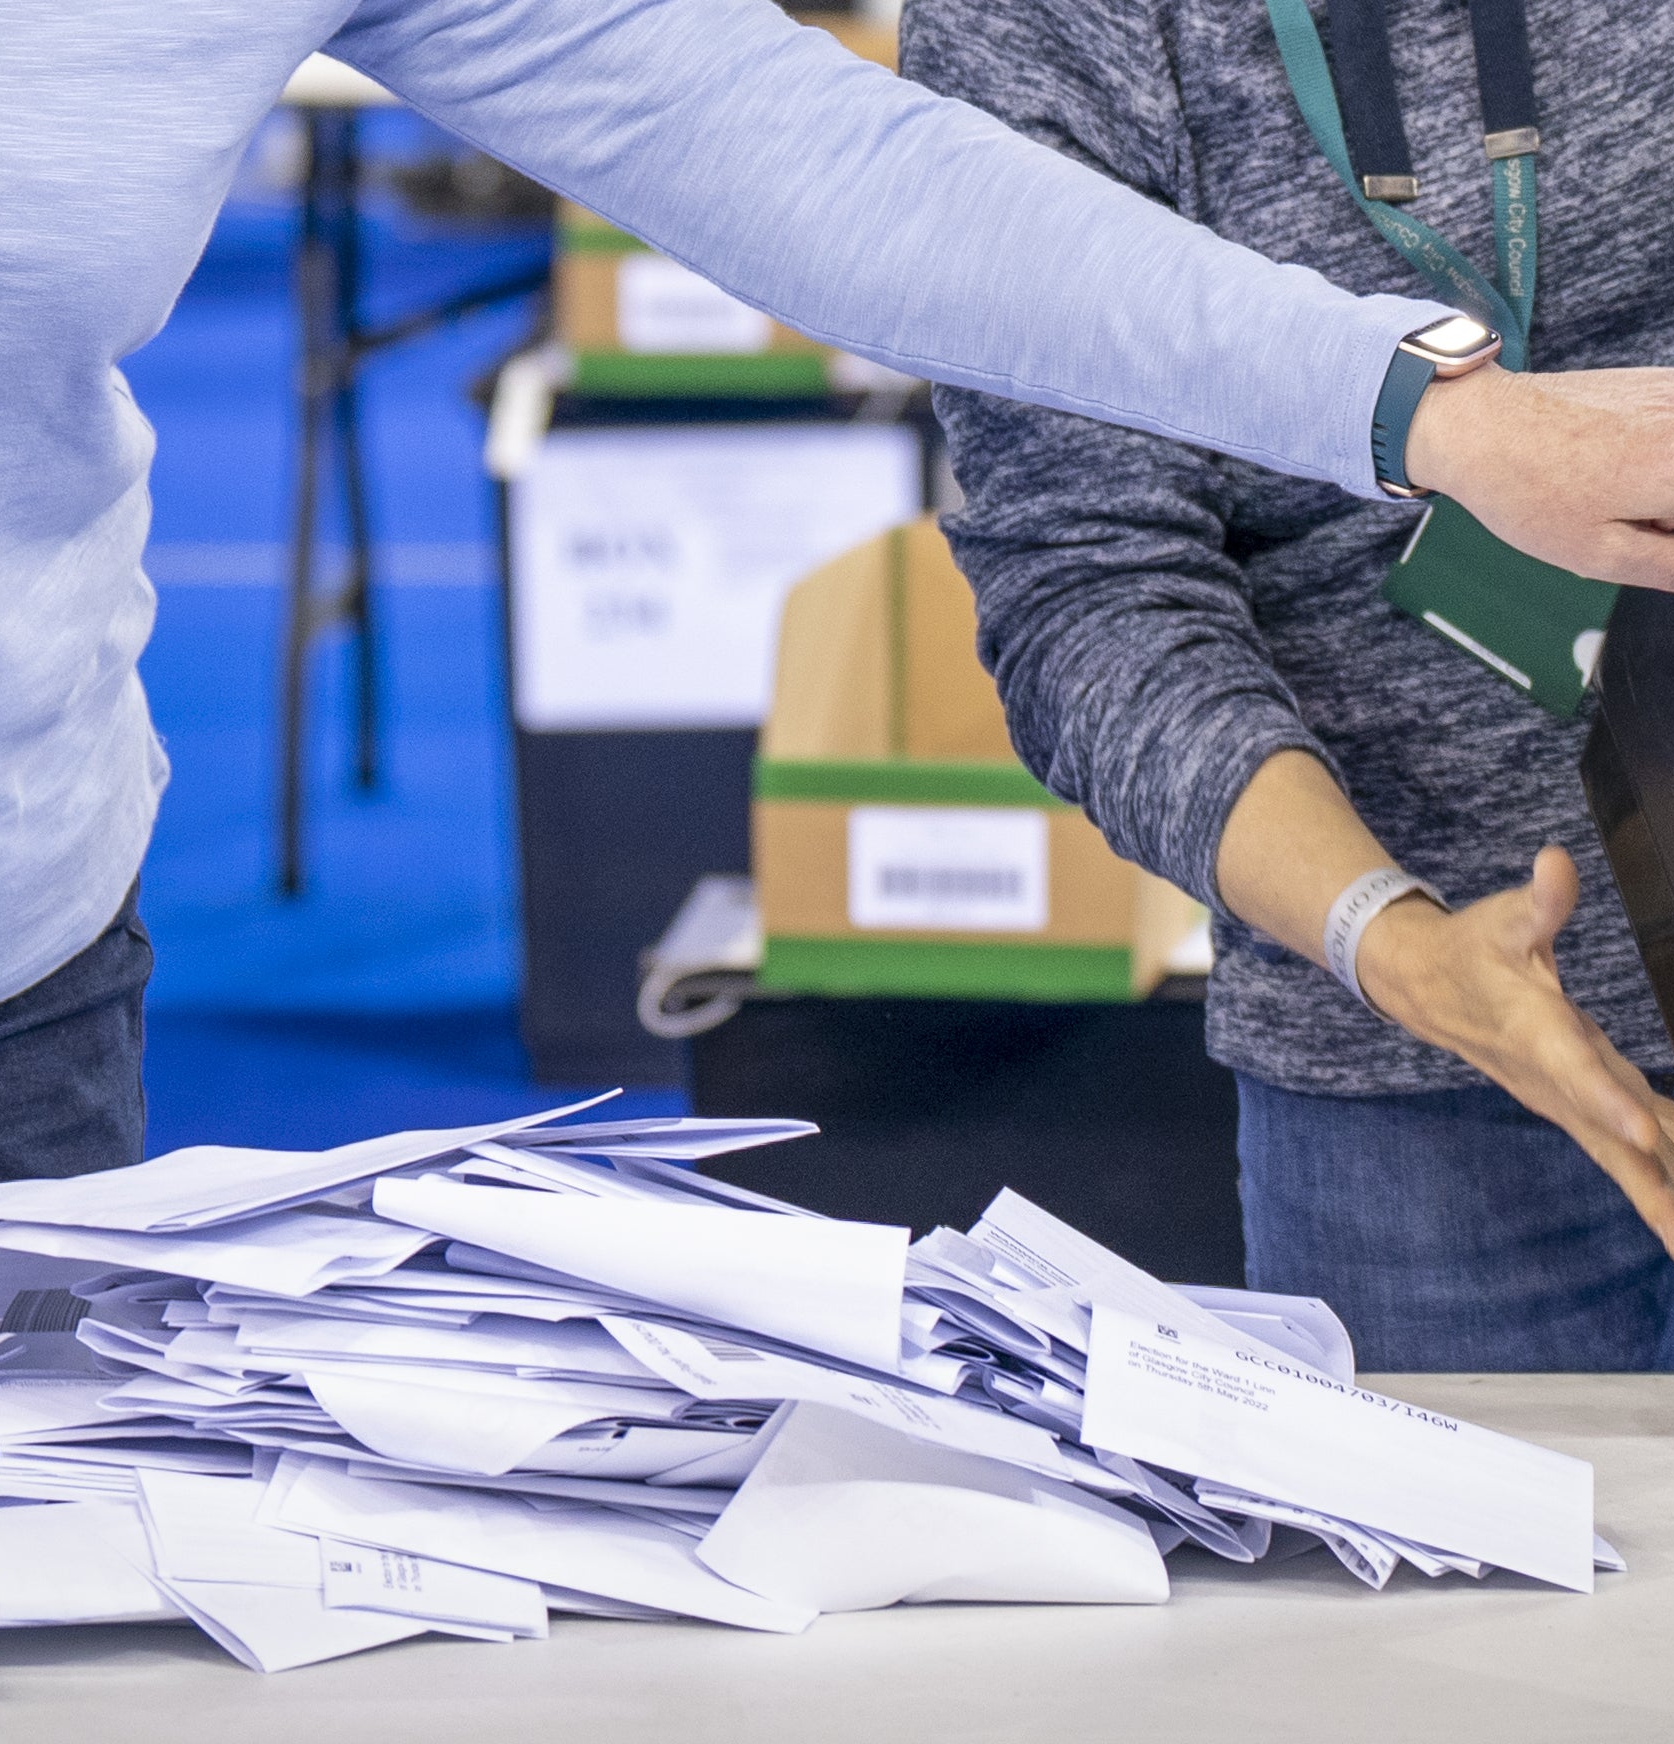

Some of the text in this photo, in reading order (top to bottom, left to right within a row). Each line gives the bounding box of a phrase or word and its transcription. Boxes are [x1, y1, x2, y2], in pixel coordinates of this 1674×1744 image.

[1505, 204, 1526, 234] City
[1508, 237, 1526, 298] Council
[1128, 1350, 1255, 1396] of Glasgow City Council
[1130, 1340, 1173, 1360] Election
[1176, 1355, 1189, 1366] for
[1192, 1361, 1209, 1372] the
[1212, 1367, 1241, 1383] Ward
[1128, 1360, 1269, 1411] on Thursday 5th May 2022
